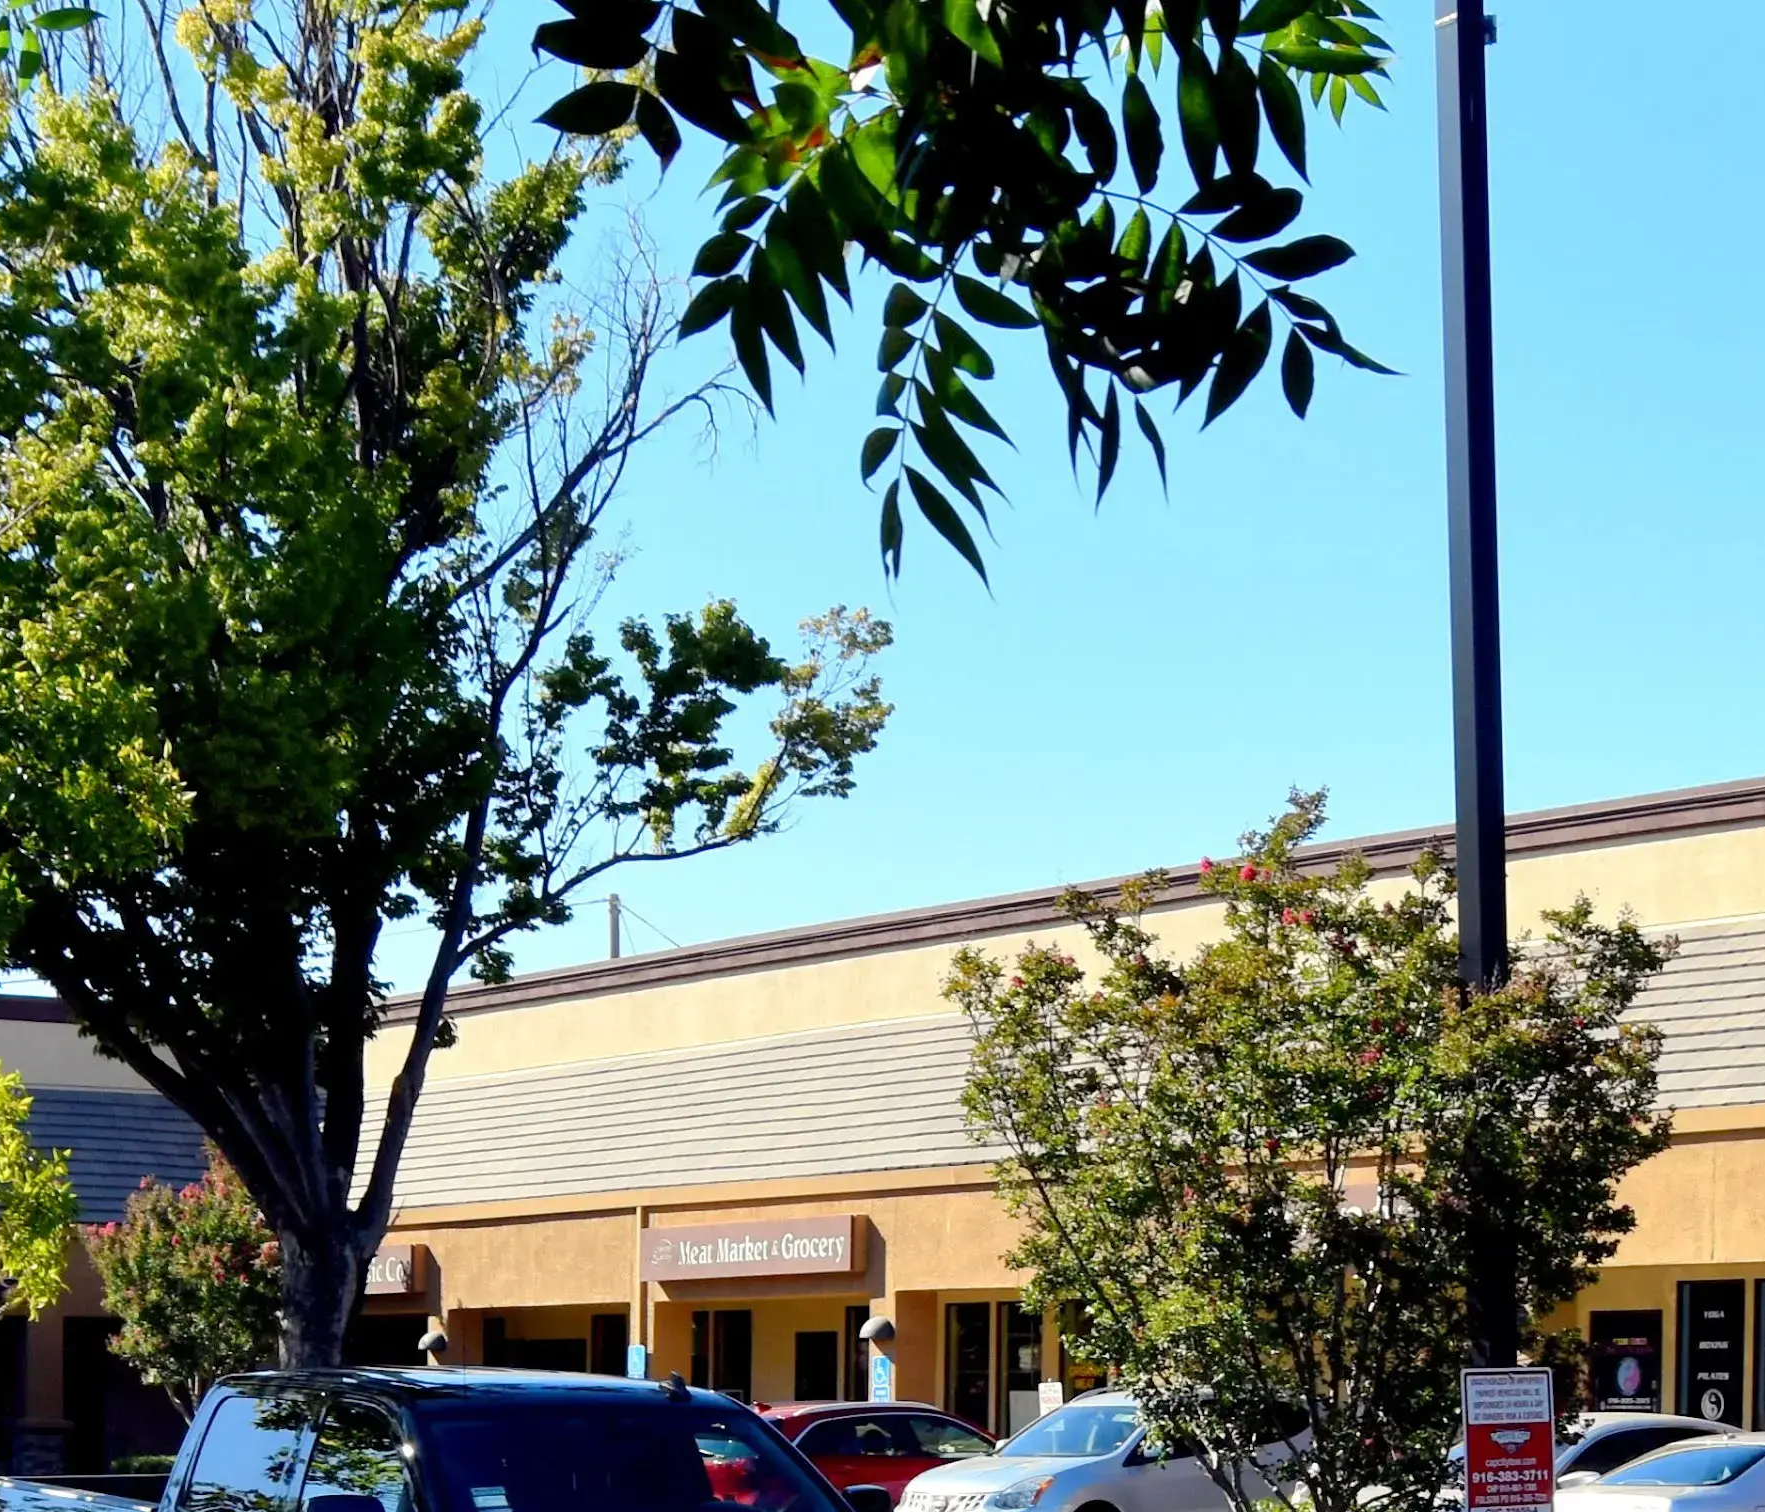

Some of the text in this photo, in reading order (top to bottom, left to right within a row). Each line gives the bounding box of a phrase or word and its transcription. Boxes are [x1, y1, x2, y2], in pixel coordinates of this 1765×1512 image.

[677, 1240, 714, 1265] Meat
[716, 1235, 769, 1264] Market
[771, 1239, 780, 1256] &
[781, 1232, 845, 1263] Grocery
[1697, 1371, 1730, 1380] PILATES
[1471, 1469, 1549, 1483] 916-383-3711
